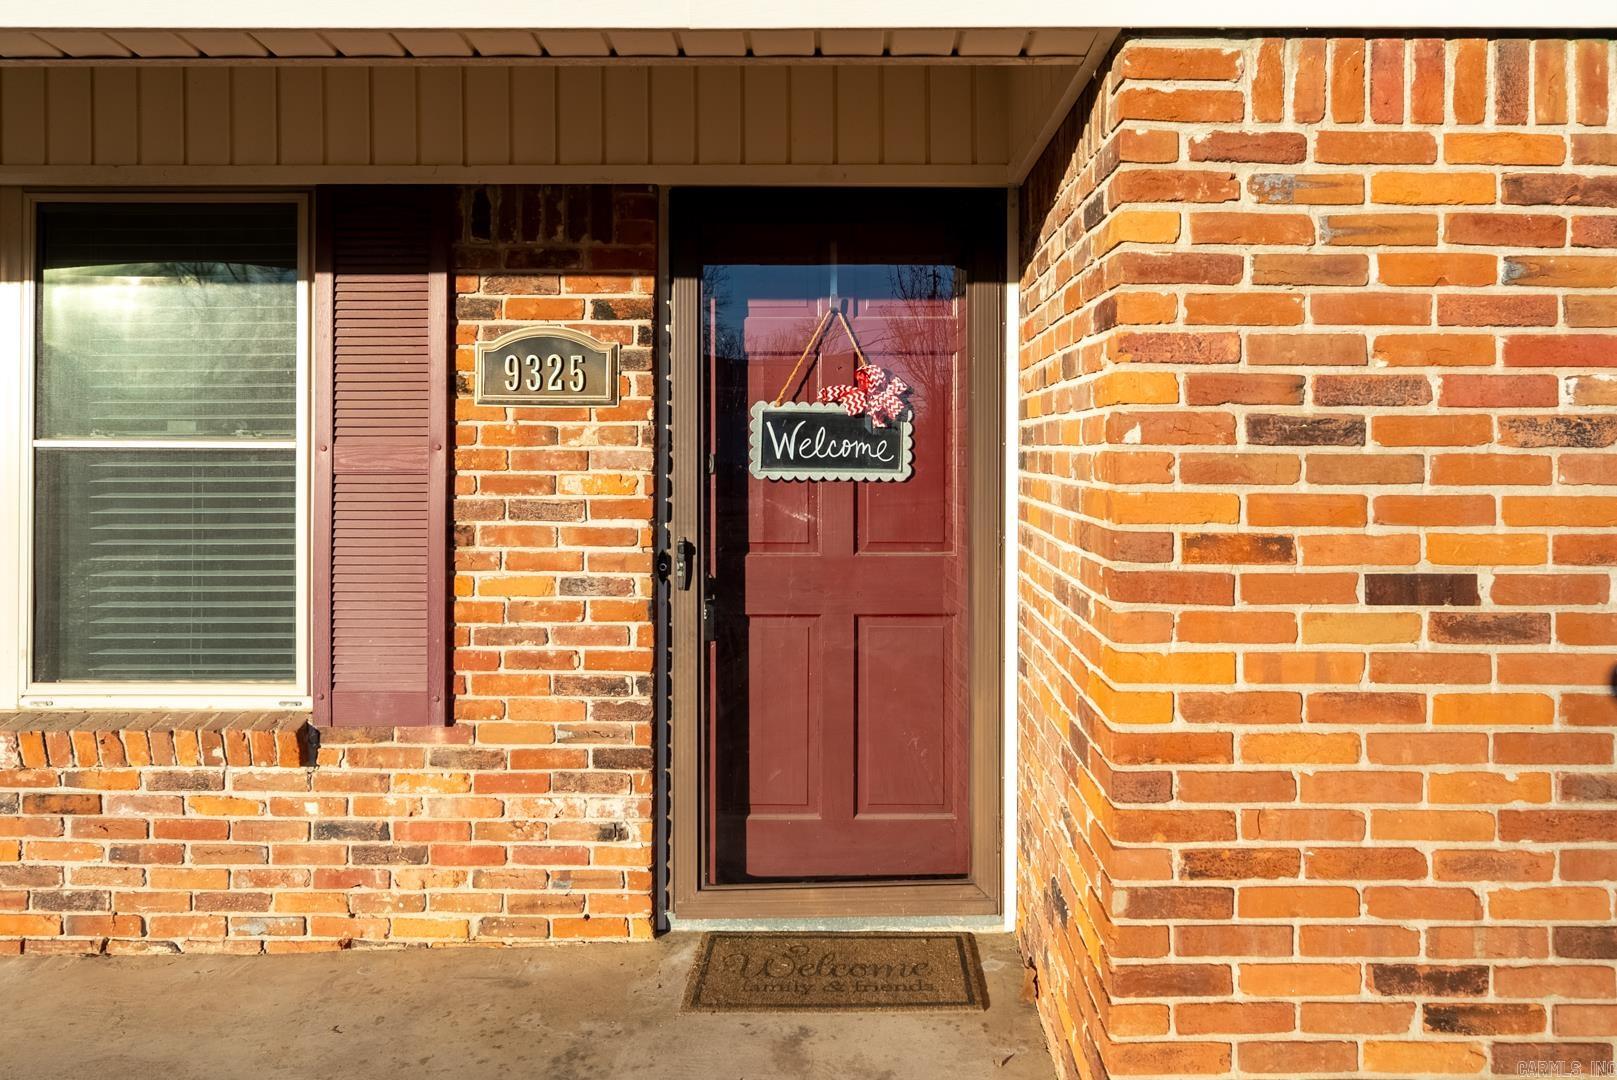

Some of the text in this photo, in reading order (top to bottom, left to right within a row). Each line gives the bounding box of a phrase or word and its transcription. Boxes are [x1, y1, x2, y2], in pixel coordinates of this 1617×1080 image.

[504, 353, 585, 392] 9325
[766, 420, 894, 462] Welcome
[722, 945, 931, 978] Welcome
[742, 979, 934, 995] family & friends
